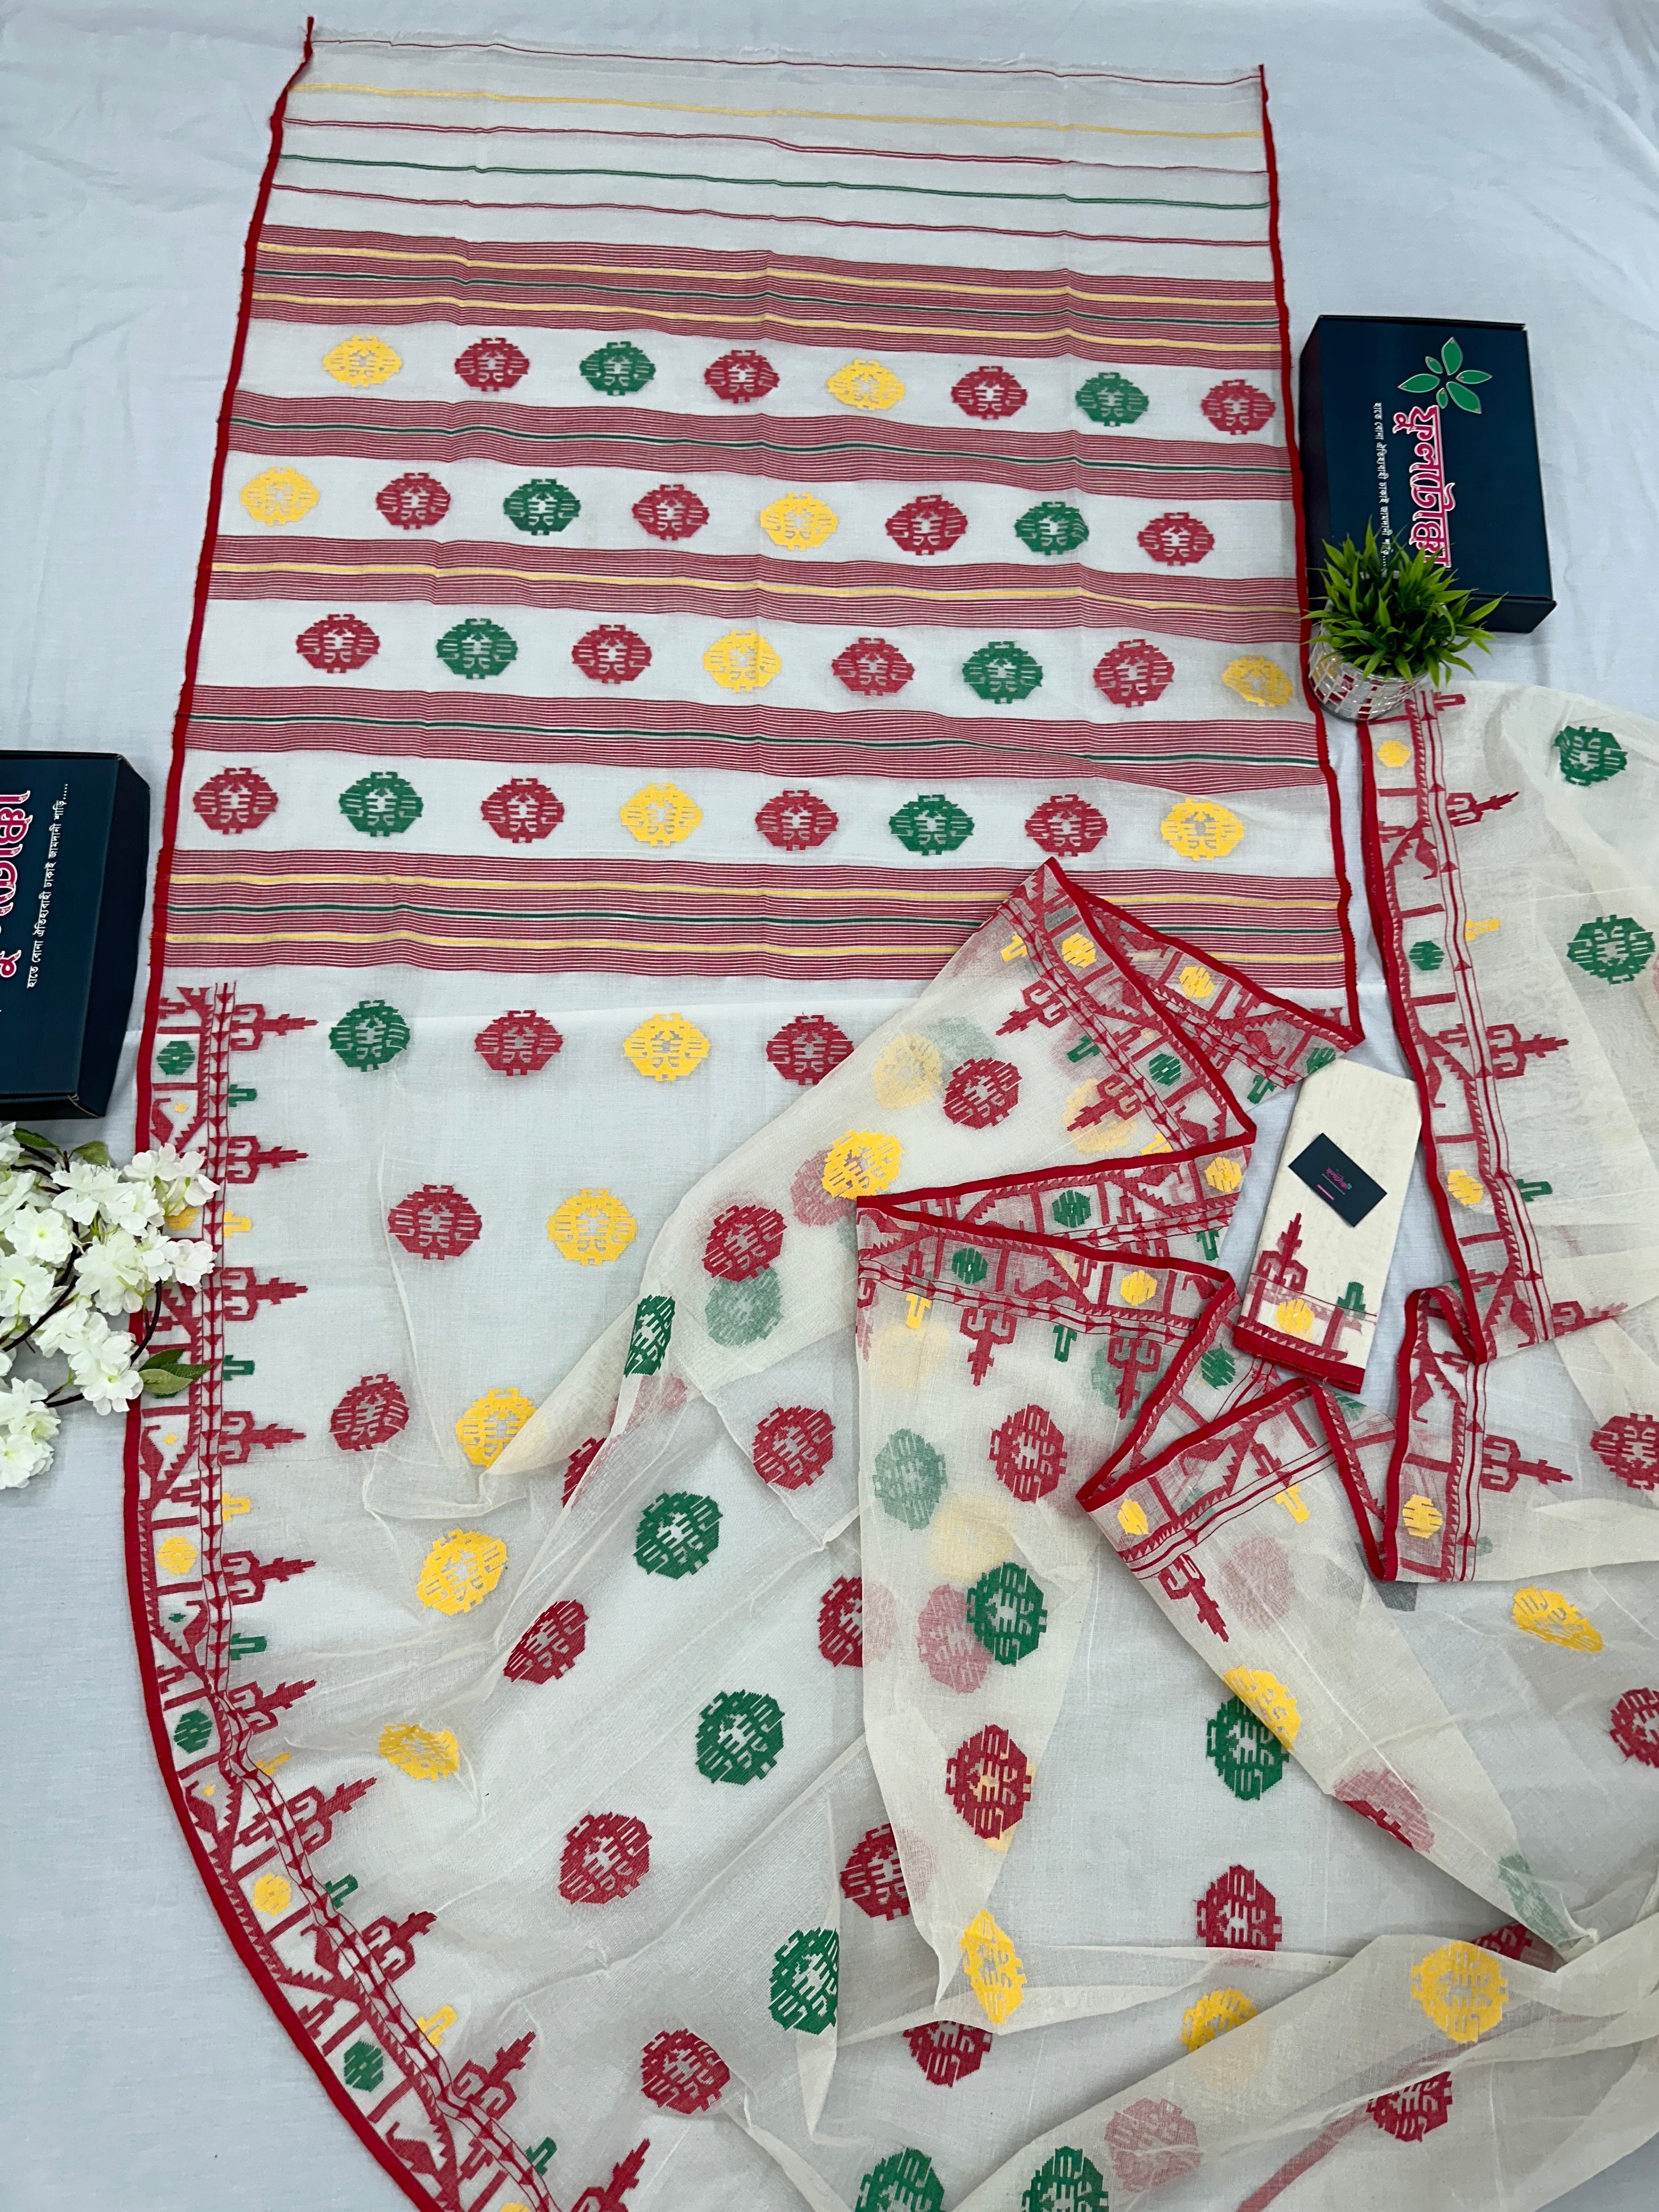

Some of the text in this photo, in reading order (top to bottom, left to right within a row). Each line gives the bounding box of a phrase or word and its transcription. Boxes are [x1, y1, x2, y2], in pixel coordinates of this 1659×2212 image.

[1373, 402, 1383, 420] হাতে
[1374, 422, 1384, 440] বোনা
[48, 823, 62, 859] জামদানী
[44, 862, 56, 888] ঢাকাই
[32, 891, 52, 937] ঐতিহ্যবাহী
[31, 940, 44, 963] বোনা
[27, 966, 39, 988] হাতে
